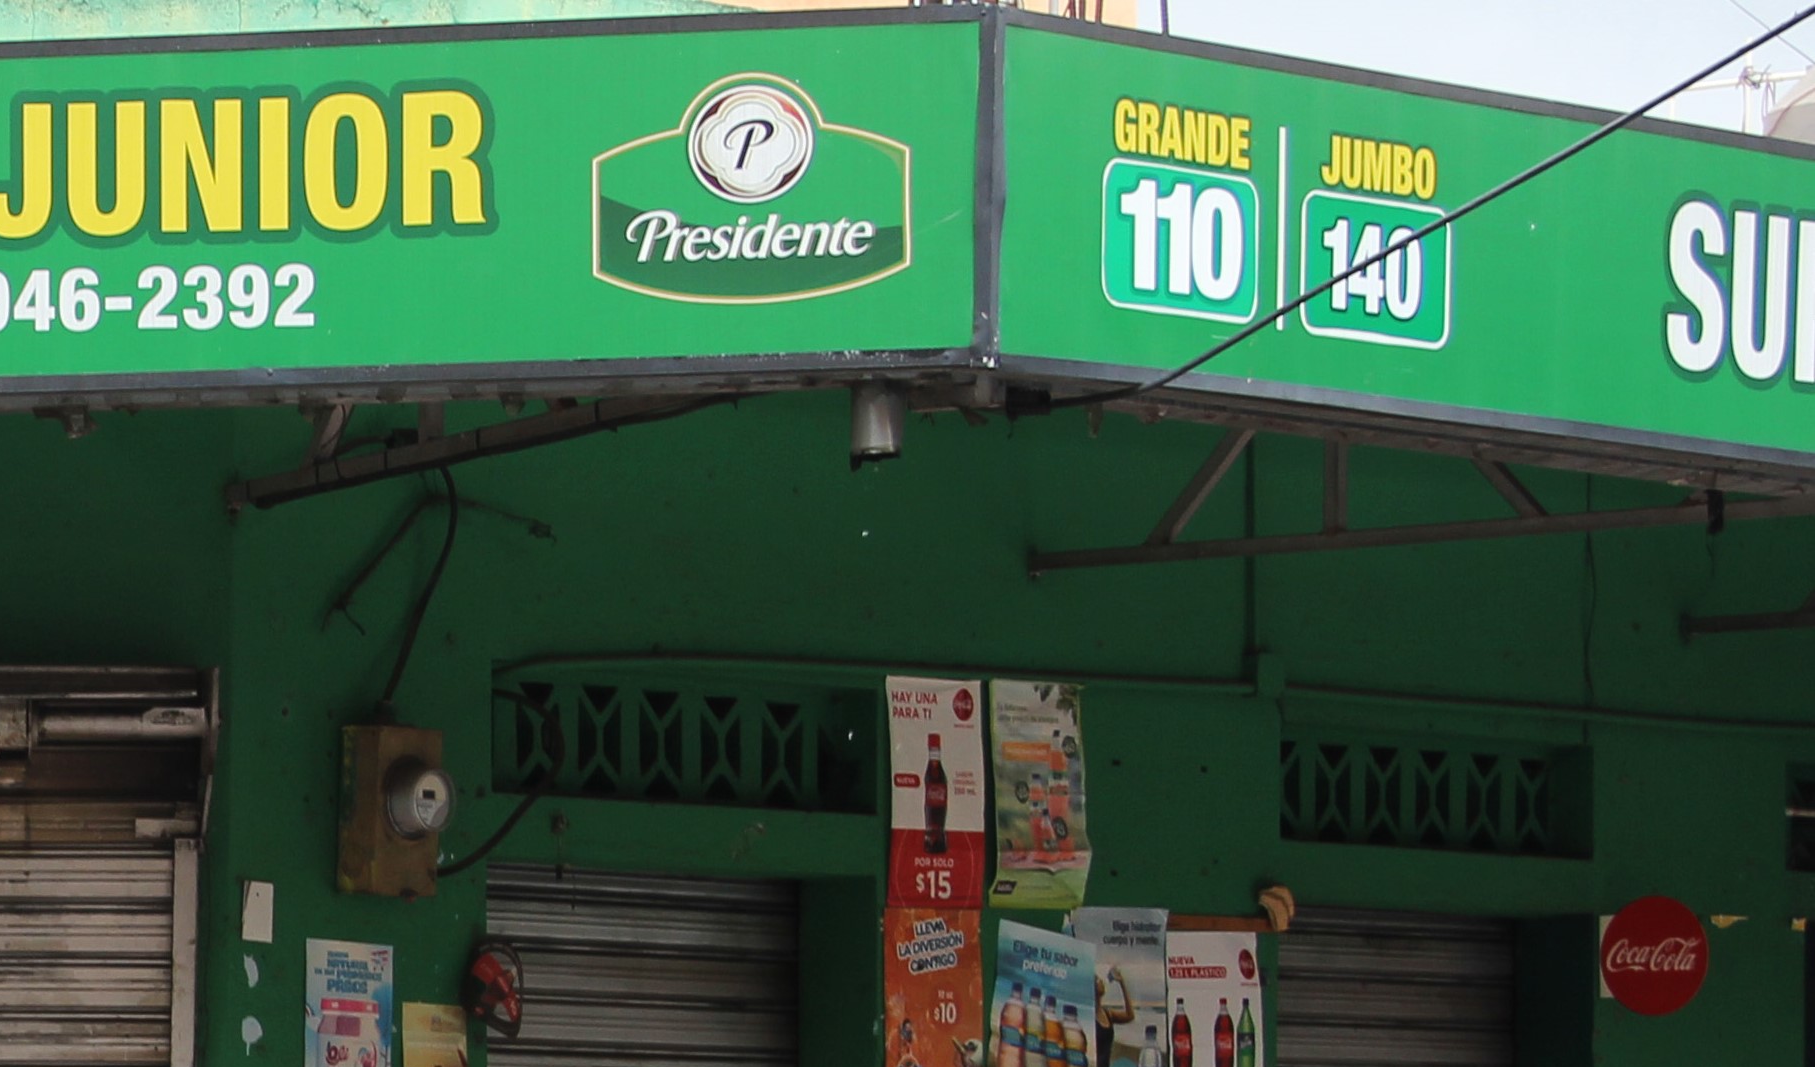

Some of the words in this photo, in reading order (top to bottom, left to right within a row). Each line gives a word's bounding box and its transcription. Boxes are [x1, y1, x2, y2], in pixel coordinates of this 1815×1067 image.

[1114, 97, 1251, 171] GRANDE
[1321, 134, 1437, 200] JUMBO
[625, 210, 877, 264] Presidente
[1120, 178, 1246, 302] 110
[1323, 217, 1423, 320] 140
[891, 690, 913, 703] HAY
[915, 692, 938, 705] UNA
[893, 706, 922, 719] PARA
[923, 708, 933, 720] TI
[914, 857, 931, 867] POR
[915, 870, 951, 899] $15
[898, 943, 911, 957] LA
[1013, 940, 1038, 957] Elige
[1040, 945, 1052, 959] tu
[1053, 949, 1078, 966] sabor
[1168, 956, 1194, 964] NUEVA
